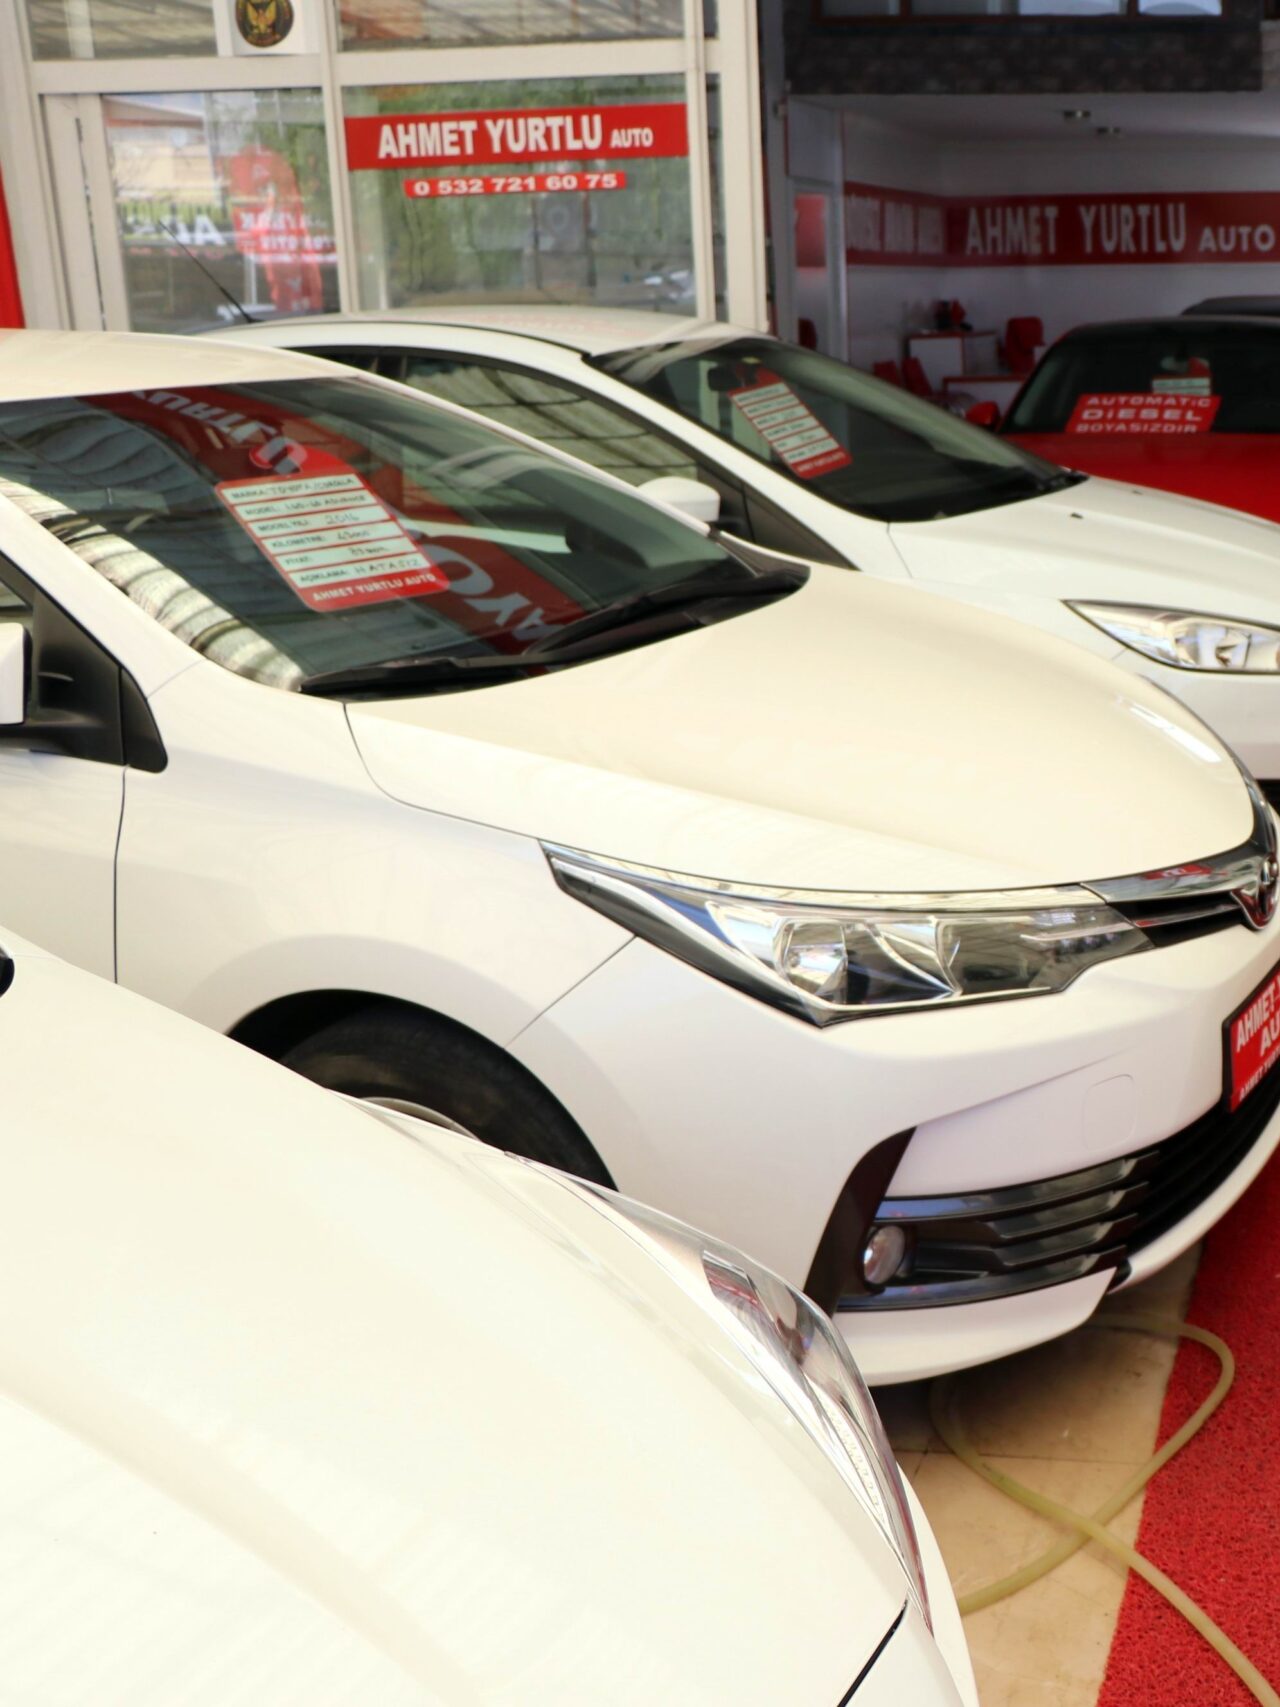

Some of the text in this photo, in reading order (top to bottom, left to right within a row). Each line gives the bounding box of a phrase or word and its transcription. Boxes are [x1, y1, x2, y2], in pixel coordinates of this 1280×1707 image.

[378, 113, 653, 160] AHMET YURTLU AUTO
[413, 172, 618, 196] 0 532 721 60 75
[965, 206, 1058, 256] AHMET
[1079, 202, 1187, 253] YURTLU
[1199, 224, 1276, 252] AUTO
[313, 573, 437, 602] AHMET YURTLU AUTO
[1236, 982, 1275, 1053] AHMET
